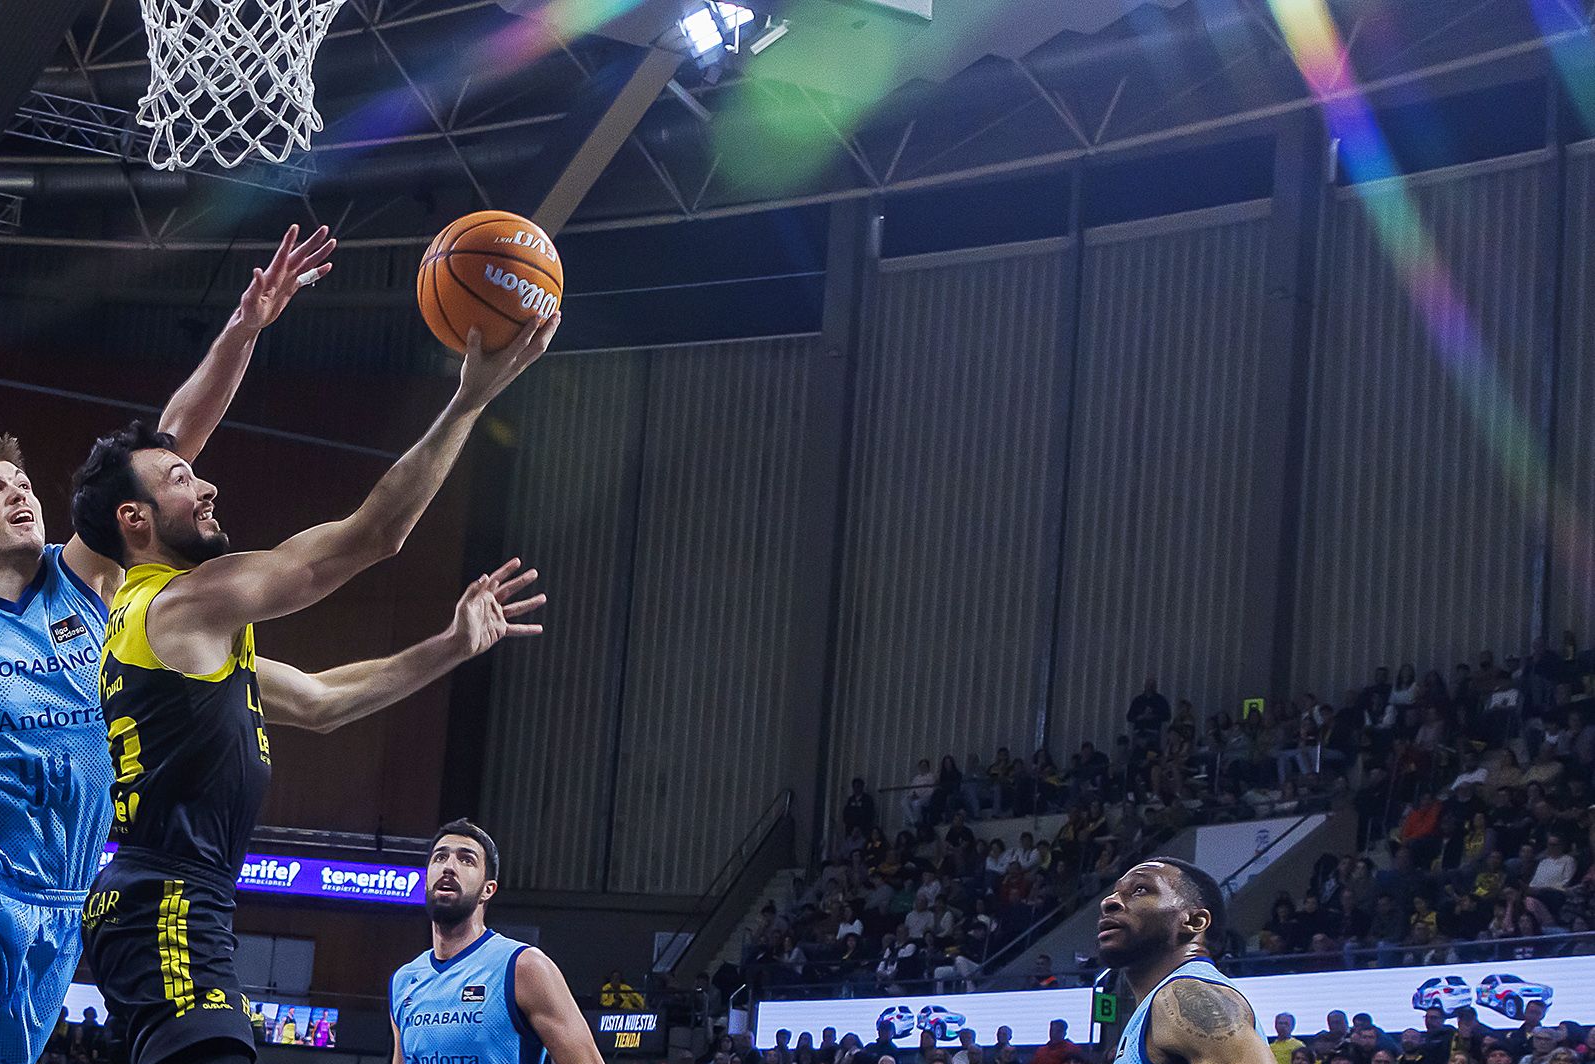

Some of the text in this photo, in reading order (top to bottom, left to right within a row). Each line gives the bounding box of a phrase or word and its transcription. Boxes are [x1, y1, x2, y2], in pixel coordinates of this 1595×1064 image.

[513, 230, 557, 263] EVO
[484, 264, 557, 320] Wilson
[240, 859, 301, 887] erife!
[321, 866, 420, 897] tenerife!
[321, 883, 361, 894] despierta
[89, 890, 120, 919] CAR
[1101, 999, 1113, 1017] B
[600, 1015, 624, 1031] VISITA
[614, 1032, 641, 1048] TIENDA
